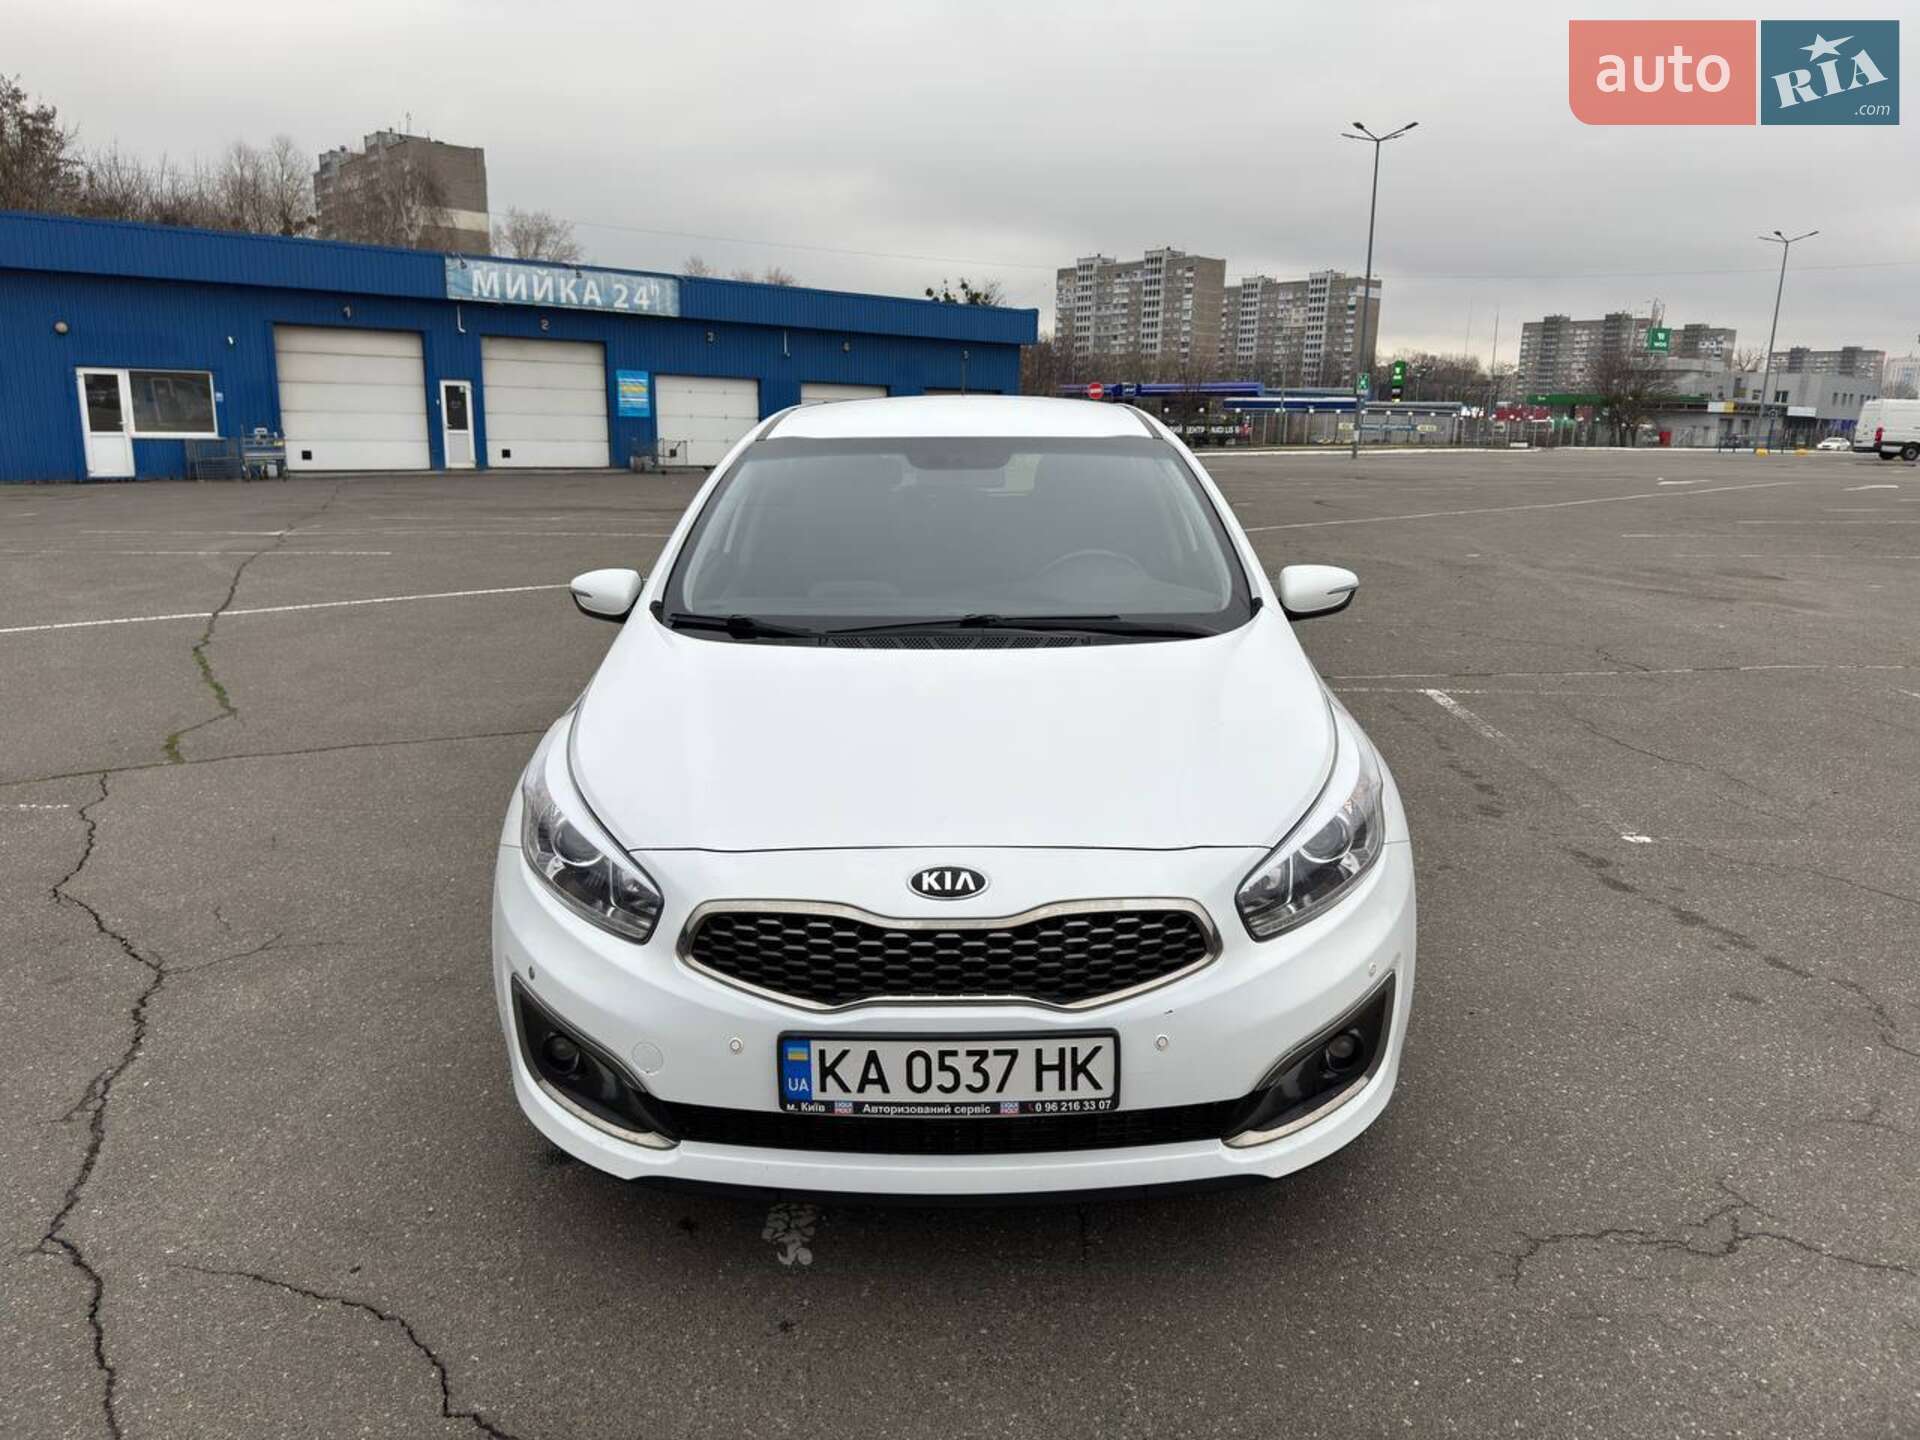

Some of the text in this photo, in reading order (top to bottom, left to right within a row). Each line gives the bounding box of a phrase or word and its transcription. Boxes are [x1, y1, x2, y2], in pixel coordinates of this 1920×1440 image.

[472, 269, 602, 306] МИЙКА
[922, 870, 976, 891] KIA
[818, 1045, 1104, 1094] KA 0537 HK
[788, 1077, 810, 1092] UA
[801, 1102, 826, 1112] Київ
[862, 1104, 952, 1116] Авторизований
[954, 1104, 991, 1116] сервіс
[1045, 1102, 1058, 1112] 96
[1061, 1102, 1081, 1112] 216
[1083, 1101, 1096, 1111] 33
[1098, 1100, 1112, 1110] 07
